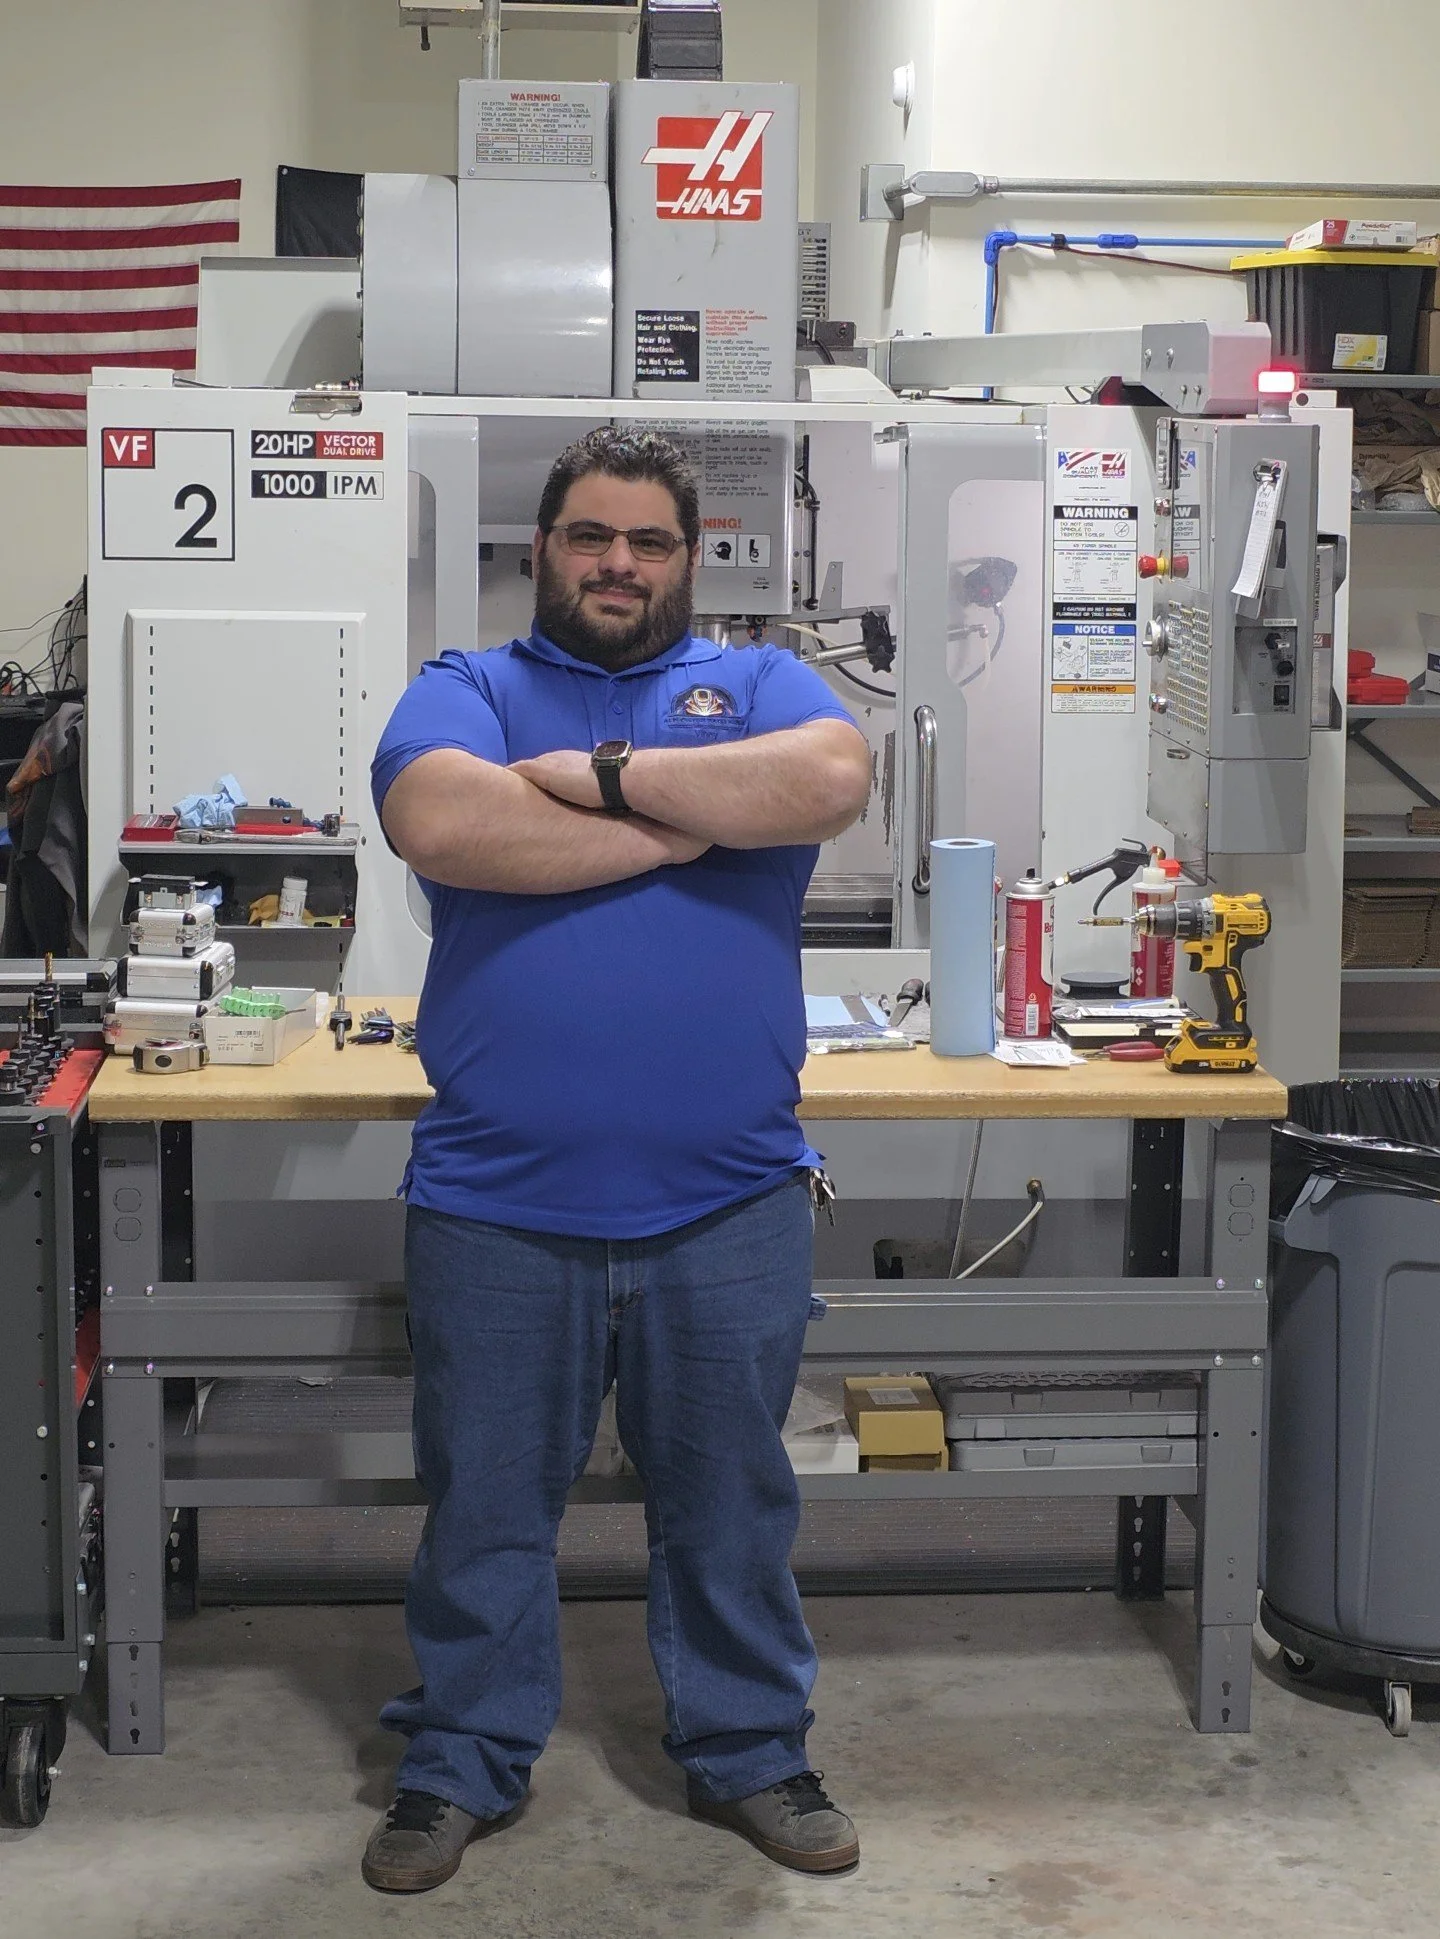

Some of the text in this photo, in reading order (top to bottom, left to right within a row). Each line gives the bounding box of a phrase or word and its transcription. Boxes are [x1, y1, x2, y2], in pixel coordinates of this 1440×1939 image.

[510, 92, 560, 101] WARNING!
[656, 188, 762, 215] HAAS
[108, 436, 147, 461] VF
[255, 434, 314, 455] 20HP
[324, 435, 376, 446] VECTOR
[323, 447, 376, 456] DUAL DRIVE
[261, 474, 314, 495] 1000
[333, 476, 378, 496] IPM
[174, 484, 218, 548] 2
[1062, 506, 1129, 518] WARNING
[703, 518, 742, 528] NING!
[1074, 625, 1115, 634] NOTICE
